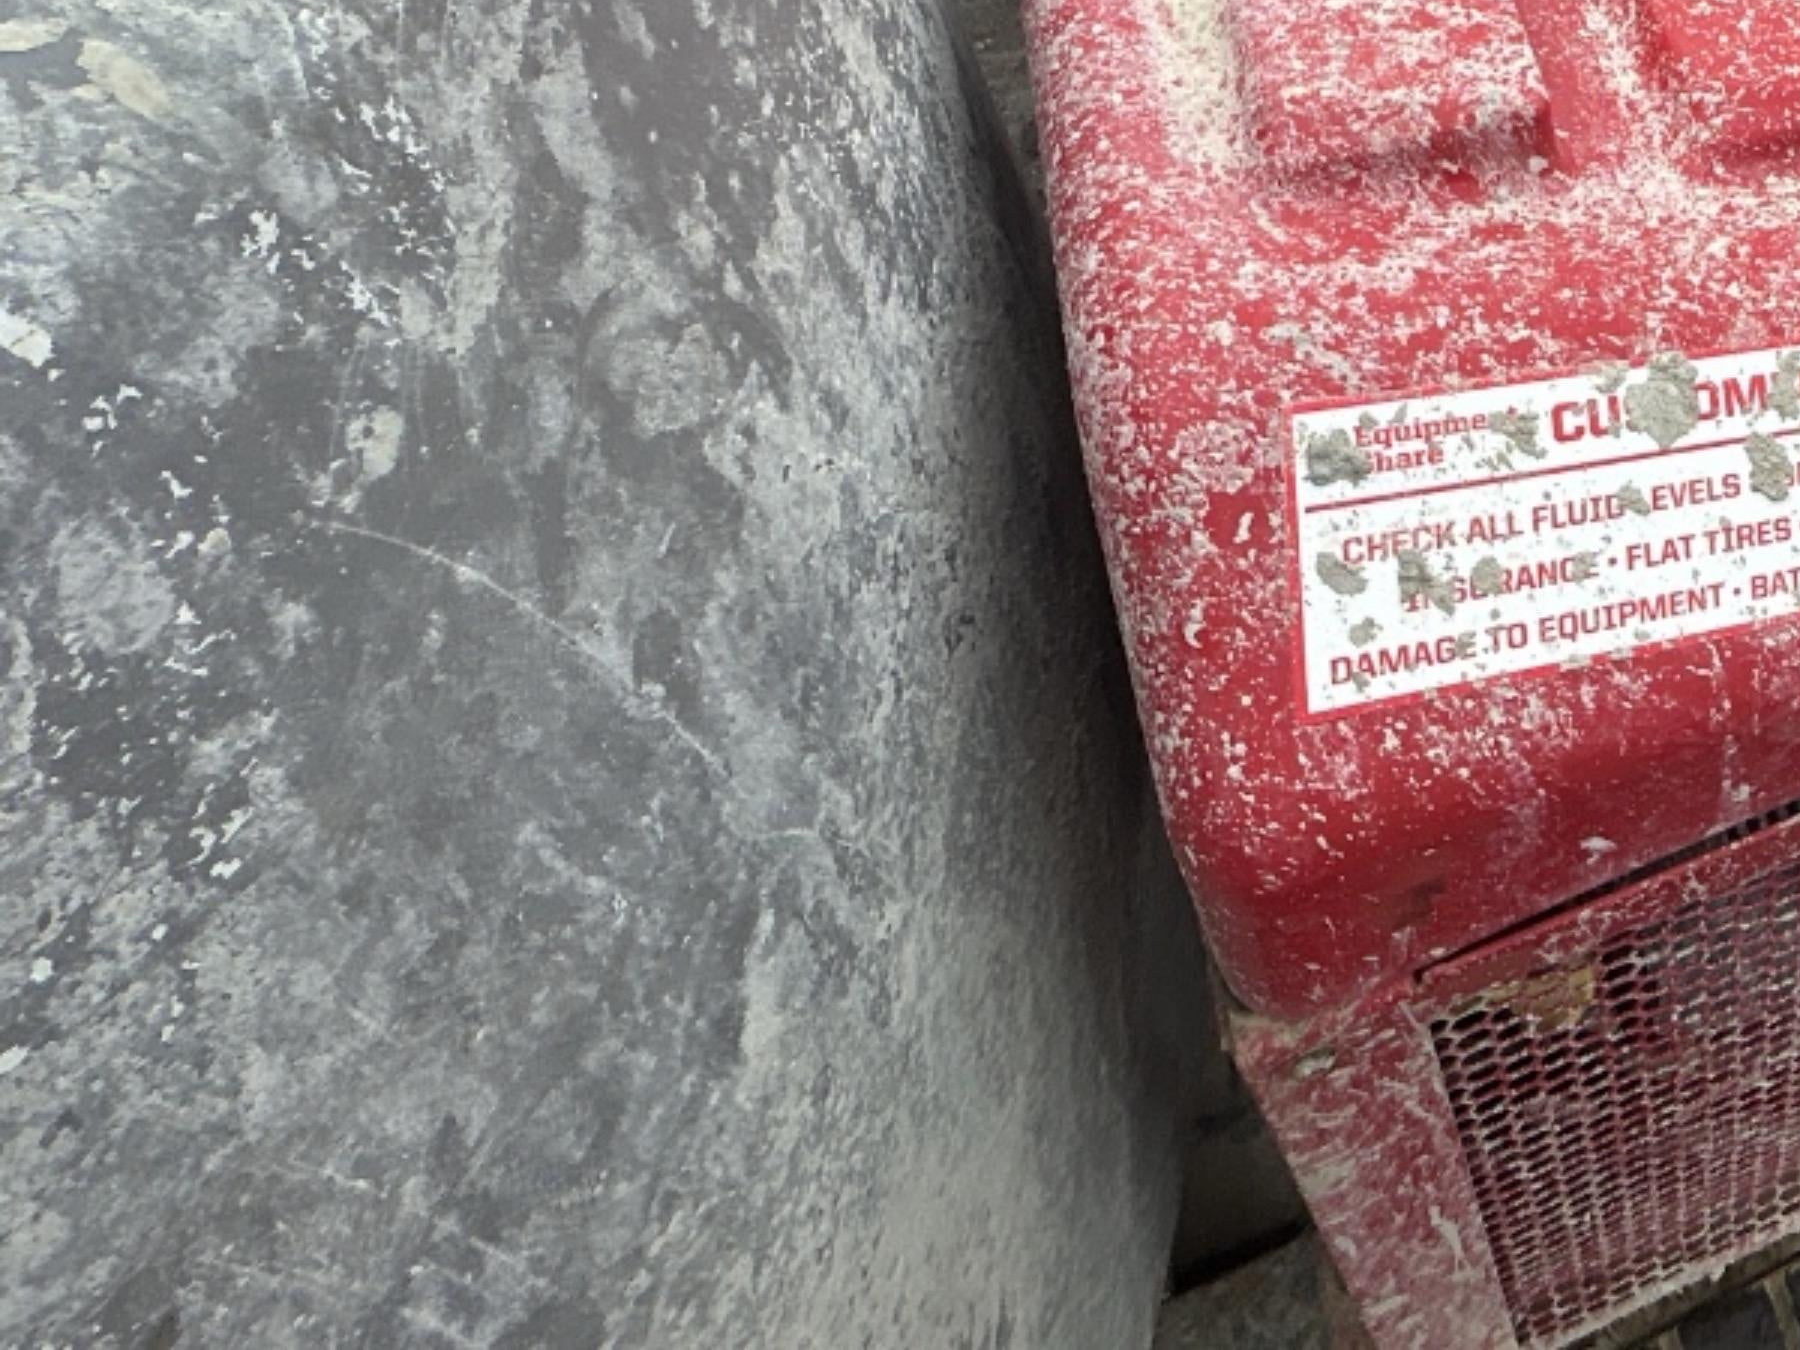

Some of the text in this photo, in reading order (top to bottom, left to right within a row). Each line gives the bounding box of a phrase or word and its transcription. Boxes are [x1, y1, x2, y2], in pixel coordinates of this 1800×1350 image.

[1353, 410, 1510, 448] Equipme
[1356, 449, 1444, 475] hare
[1342, 520, 1456, 565] CHECK
[1466, 511, 1524, 545] ALL
[1532, 494, 1625, 533] FLUID
[1634, 473, 1742, 513] EVELS
[1402, 552, 1600, 612] ISRANCE
[1626, 533, 1696, 571] FLAT
[1703, 517, 1792, 555] TIRES
[1330, 631, 1477, 686] DAMAGE
[1487, 622, 1528, 654] TO
[1538, 582, 1726, 644] EQUIPMENT
